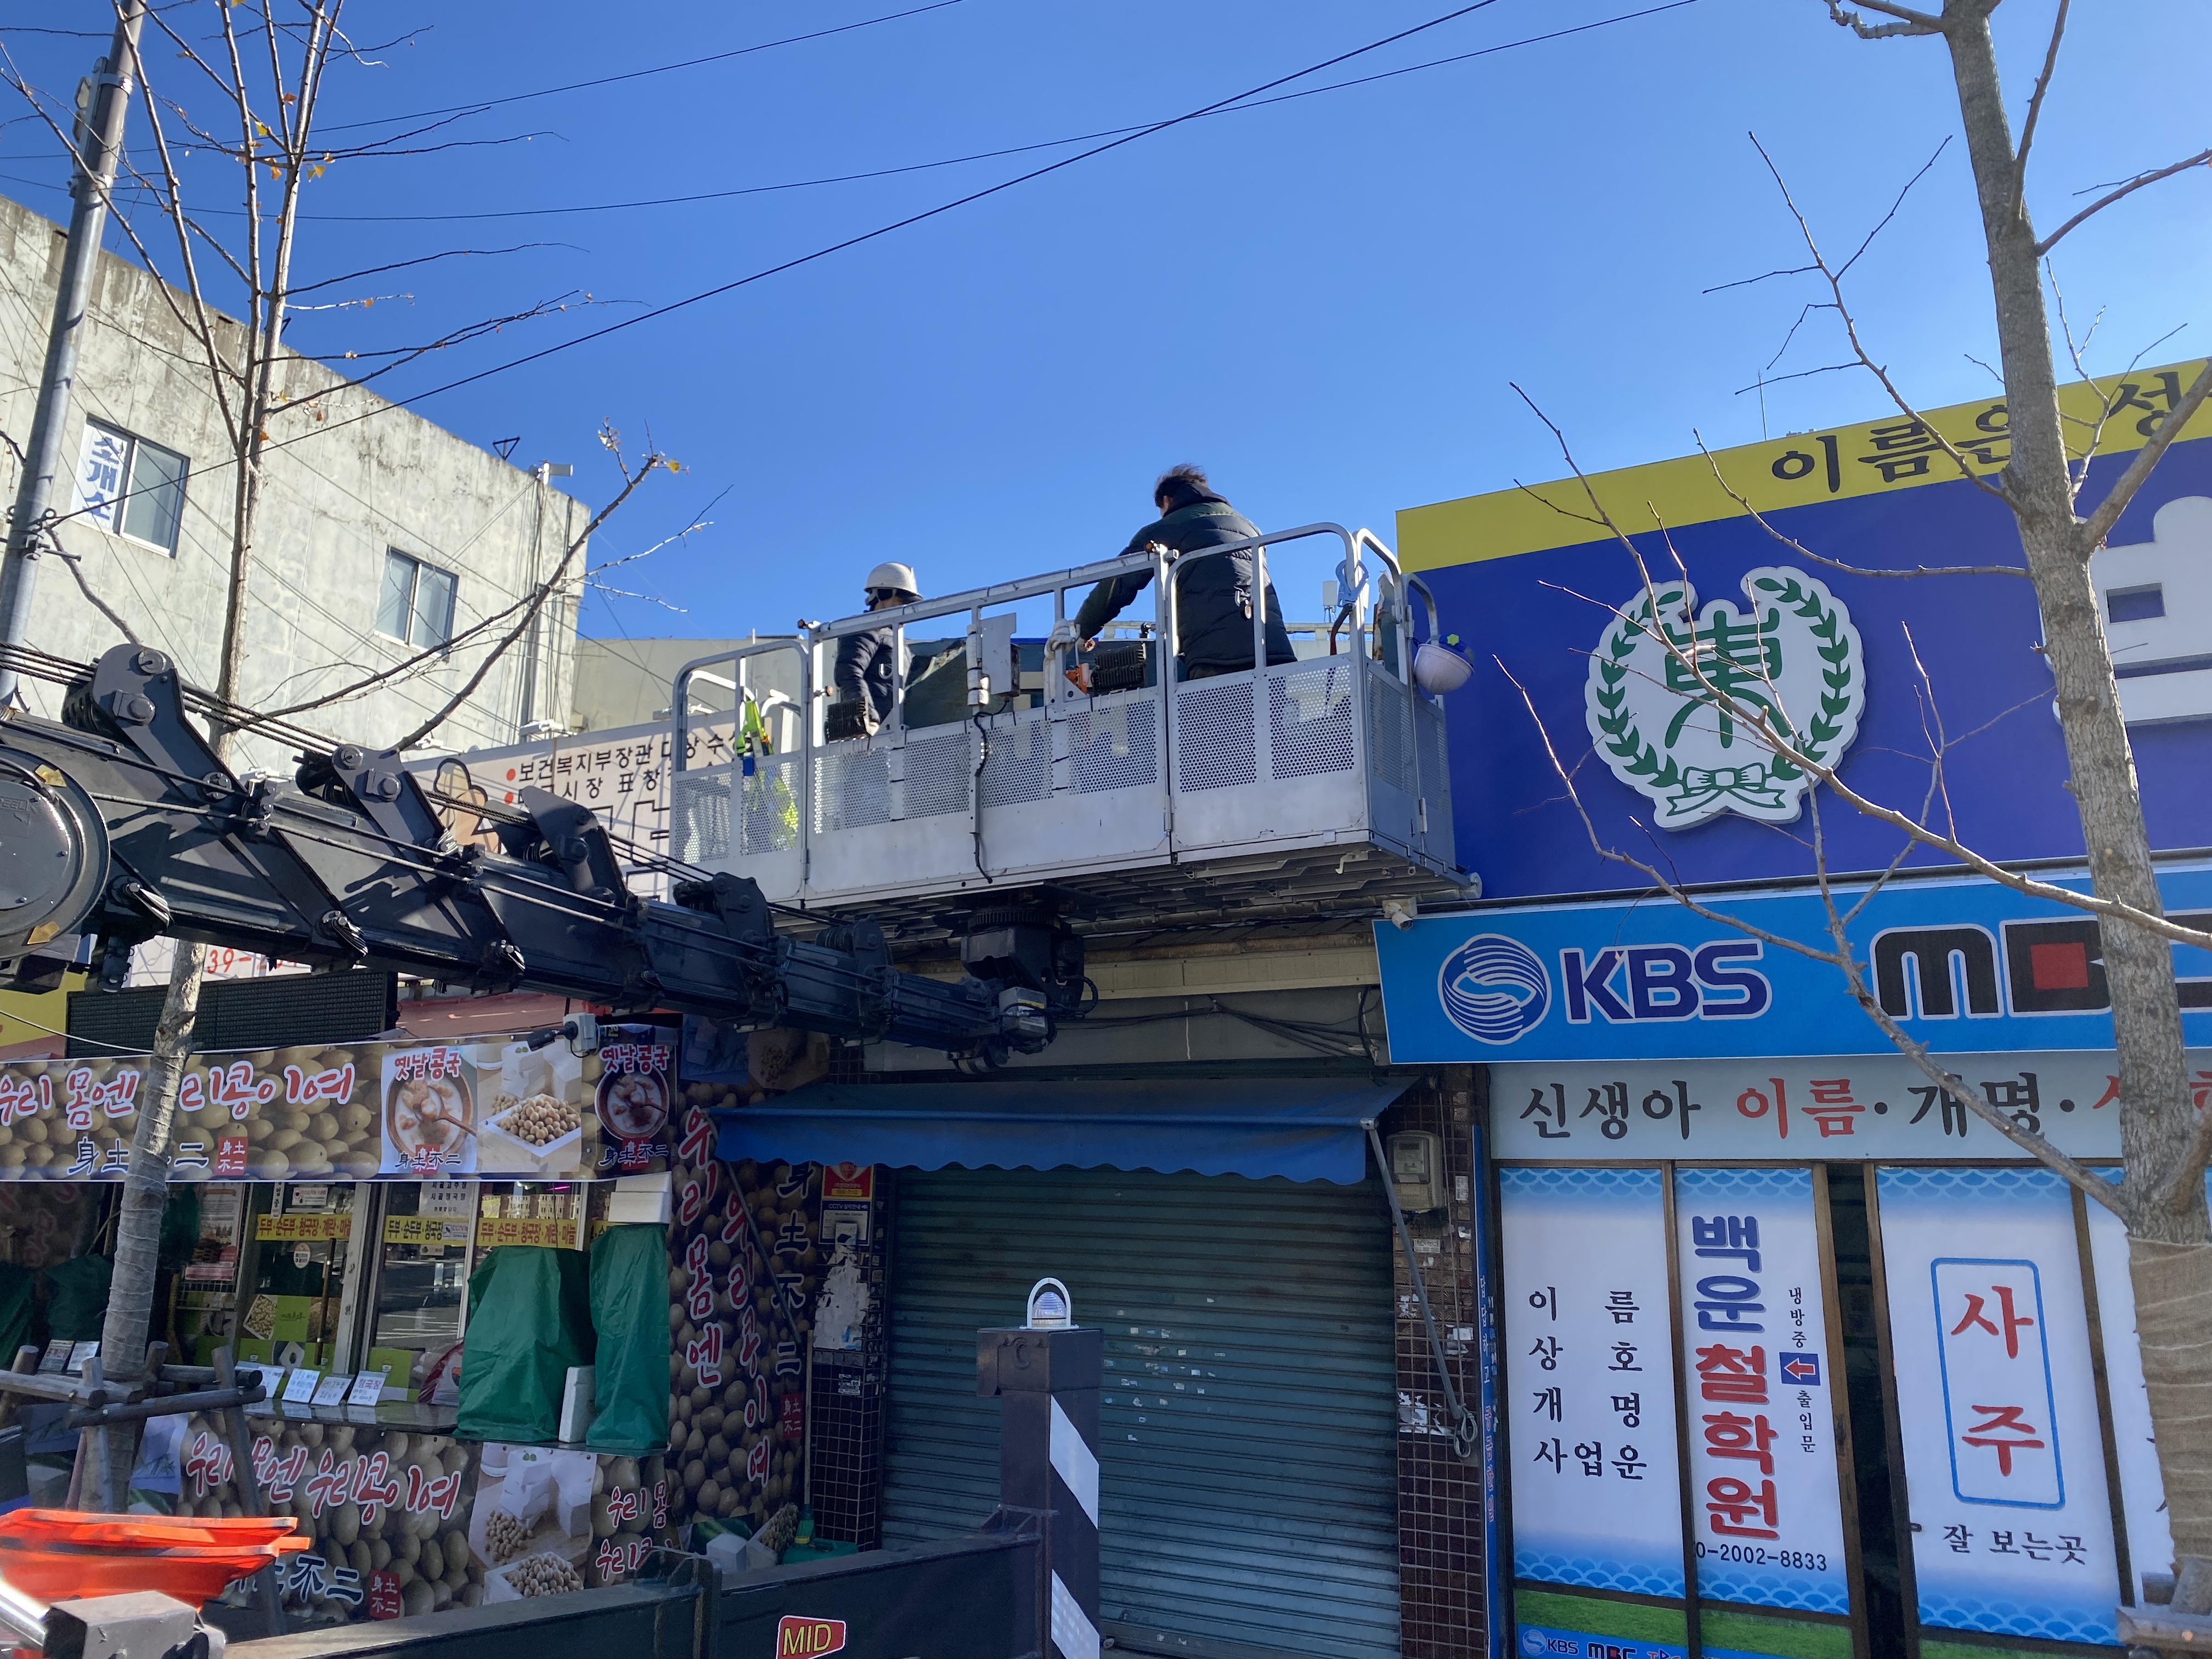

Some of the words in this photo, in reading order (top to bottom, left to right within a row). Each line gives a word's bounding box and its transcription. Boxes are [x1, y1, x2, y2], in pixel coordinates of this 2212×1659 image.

[2107, 371, 2212, 437] 성
[82, 437, 120, 520] 소개소
[519, 743, 653, 782] 보건복지부장관
[708, 731, 735, 755] 수
[618, 769, 671, 794] 표창
[1561, 939, 1773, 1025] KBS
[394, 1047, 462, 1080] 옛날콩국
[600, 1044, 670, 1074] 옛날콩국
[0, 1074, 52, 1126] 우리
[66, 1067, 139, 1130] 몸엔
[179, 1060, 355, 1119] 리콩이여
[1519, 1078, 1701, 1141] 신생아
[67, 1137, 208, 1175] 身土二
[394, 1150, 462, 1169] 身土不二
[598, 1144, 669, 1167] 身土不二
[1789, 1287, 1807, 1348] 냉방중
[359, 1378, 381, 1390] 청국장
[1951, 1285, 2045, 1477] 사주
[1797, 1390, 1816, 1453] 출입문
[186, 1431, 233, 1498] 우리
[1533, 1437, 1647, 1480] 사업운
[607, 1486, 647, 1528] 우리
[1696, 1542, 1827, 1571] 0-2002-8833
[1944, 1523, 1974, 1554] 잘
[1990, 1531, 2087, 1566] 보는곳
[782, 1623, 832, 1656] MID
[1547, 1638, 1579, 1656] KBS
